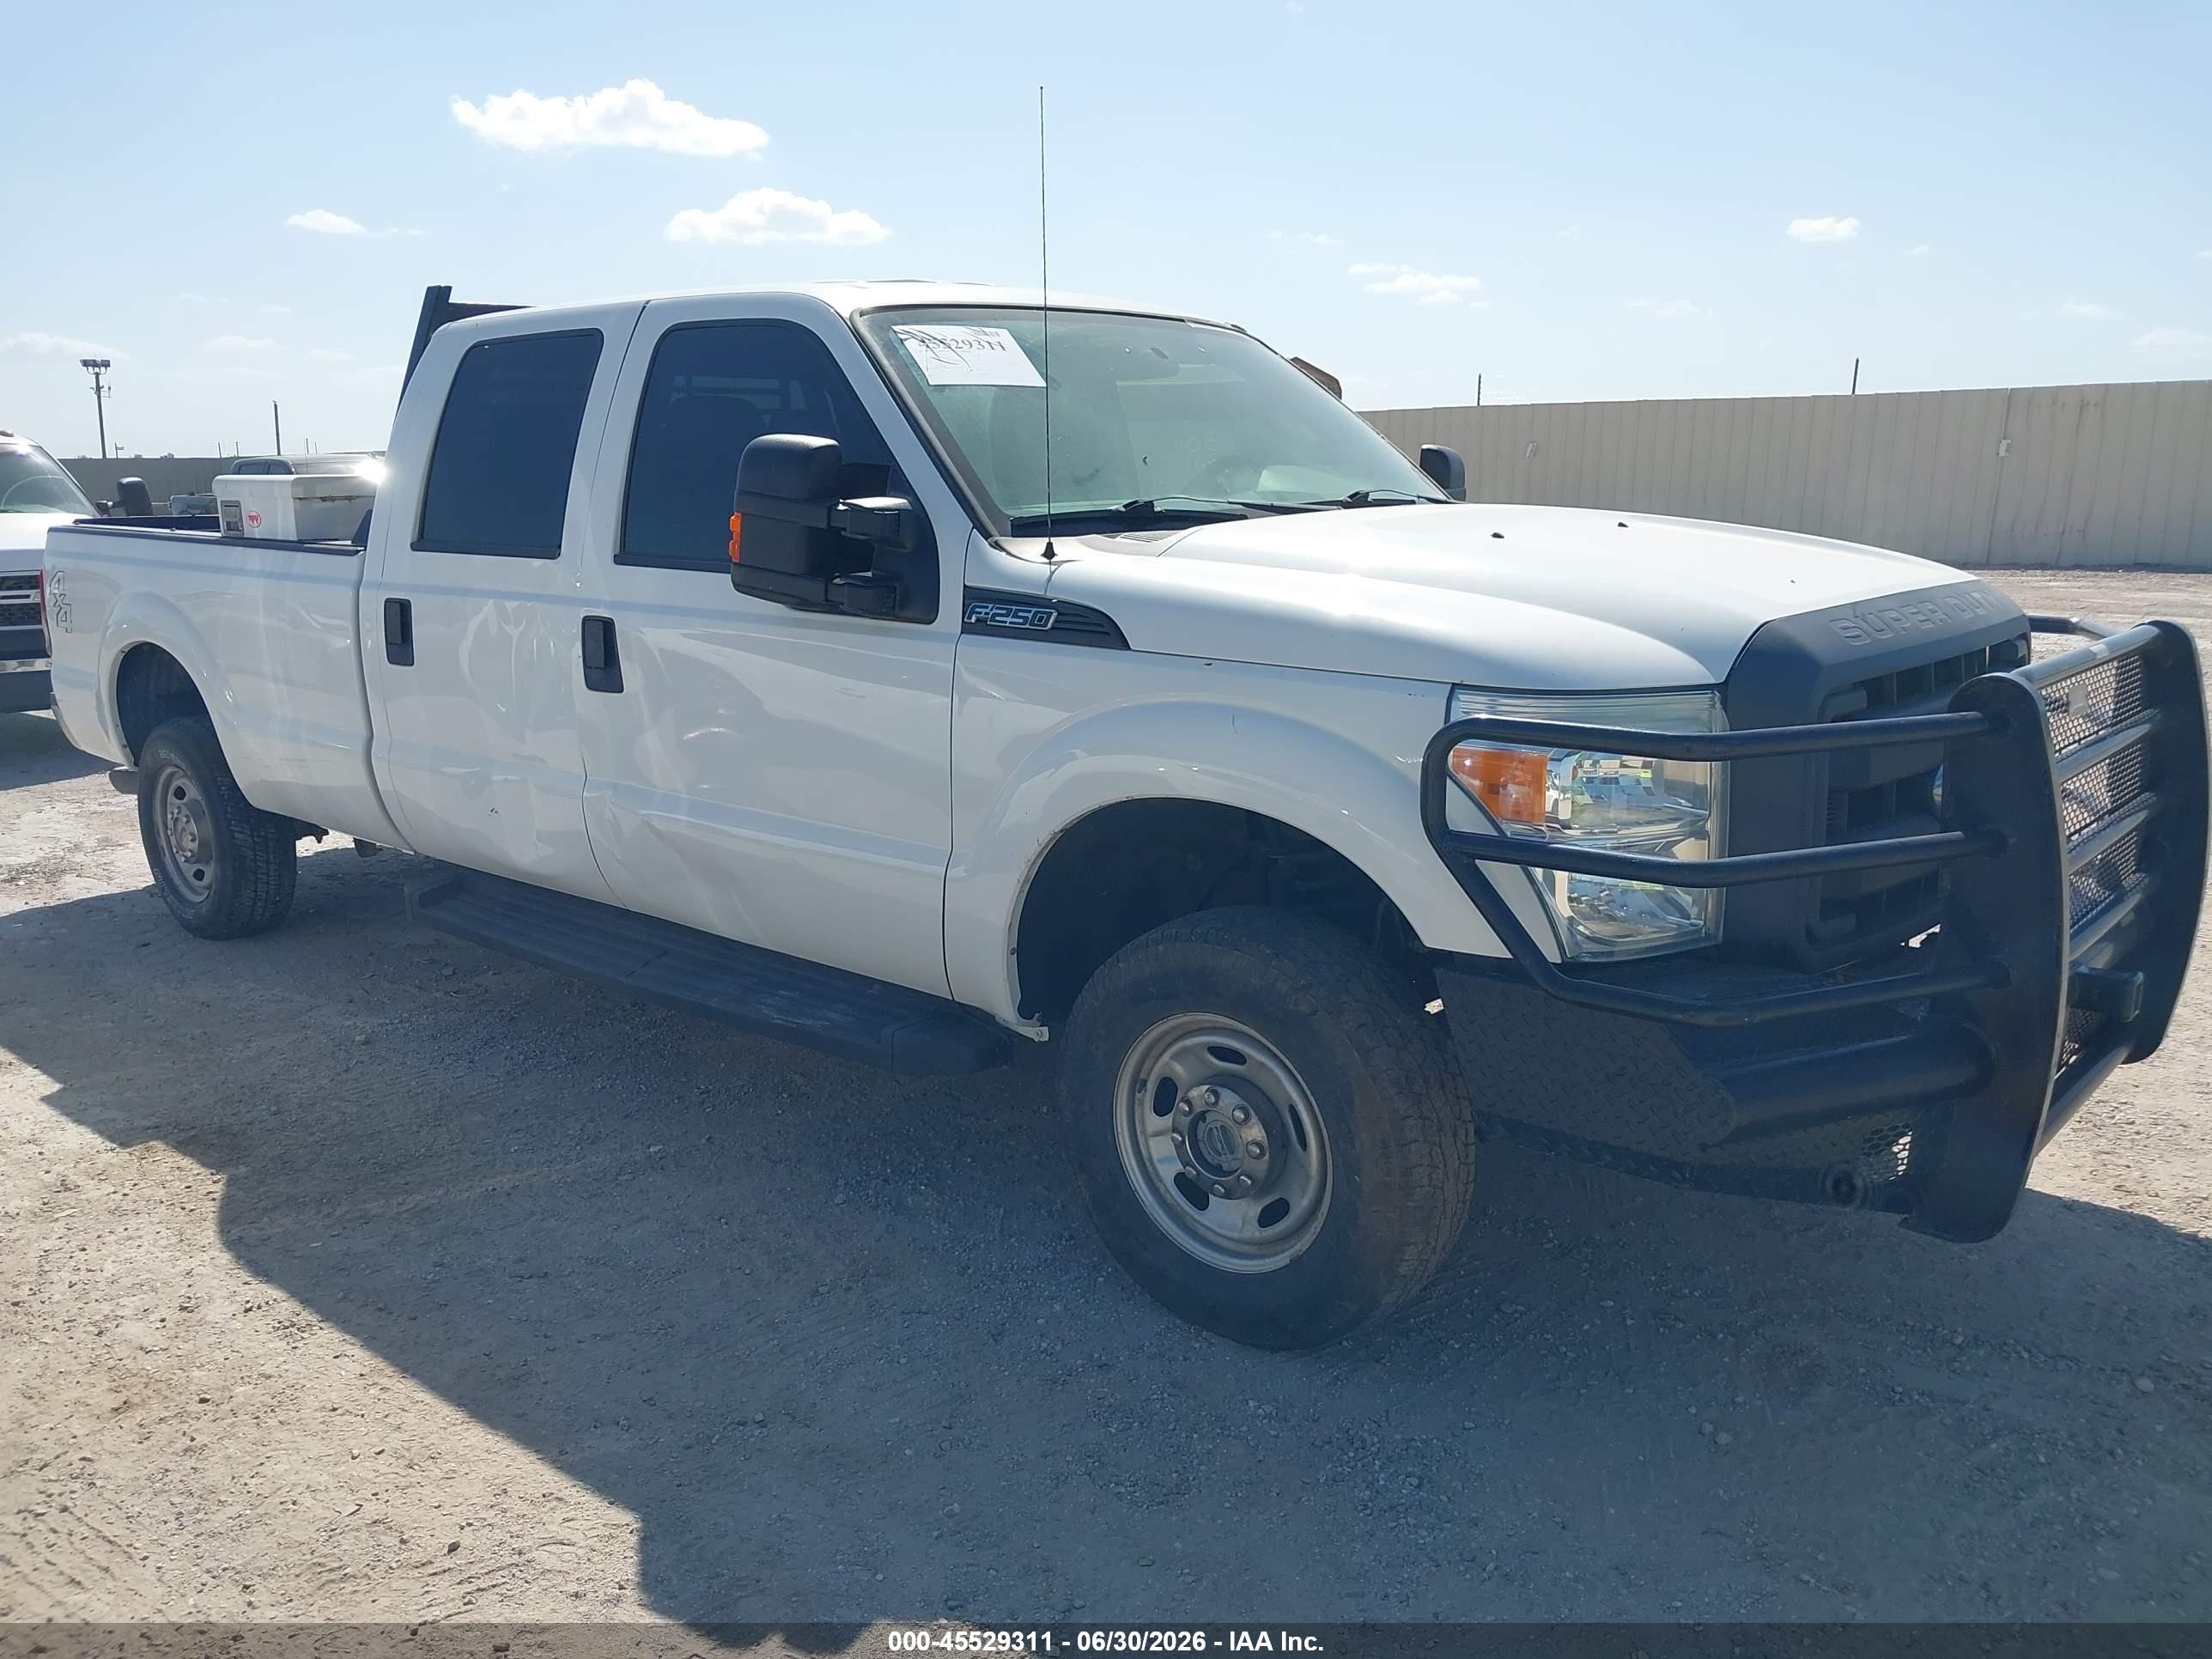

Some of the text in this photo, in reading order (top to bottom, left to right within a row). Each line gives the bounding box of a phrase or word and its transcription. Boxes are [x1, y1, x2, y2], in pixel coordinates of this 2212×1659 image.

[964, 602, 1059, 631] F-250
[1828, 589, 2004, 647] SUPER DUTY
